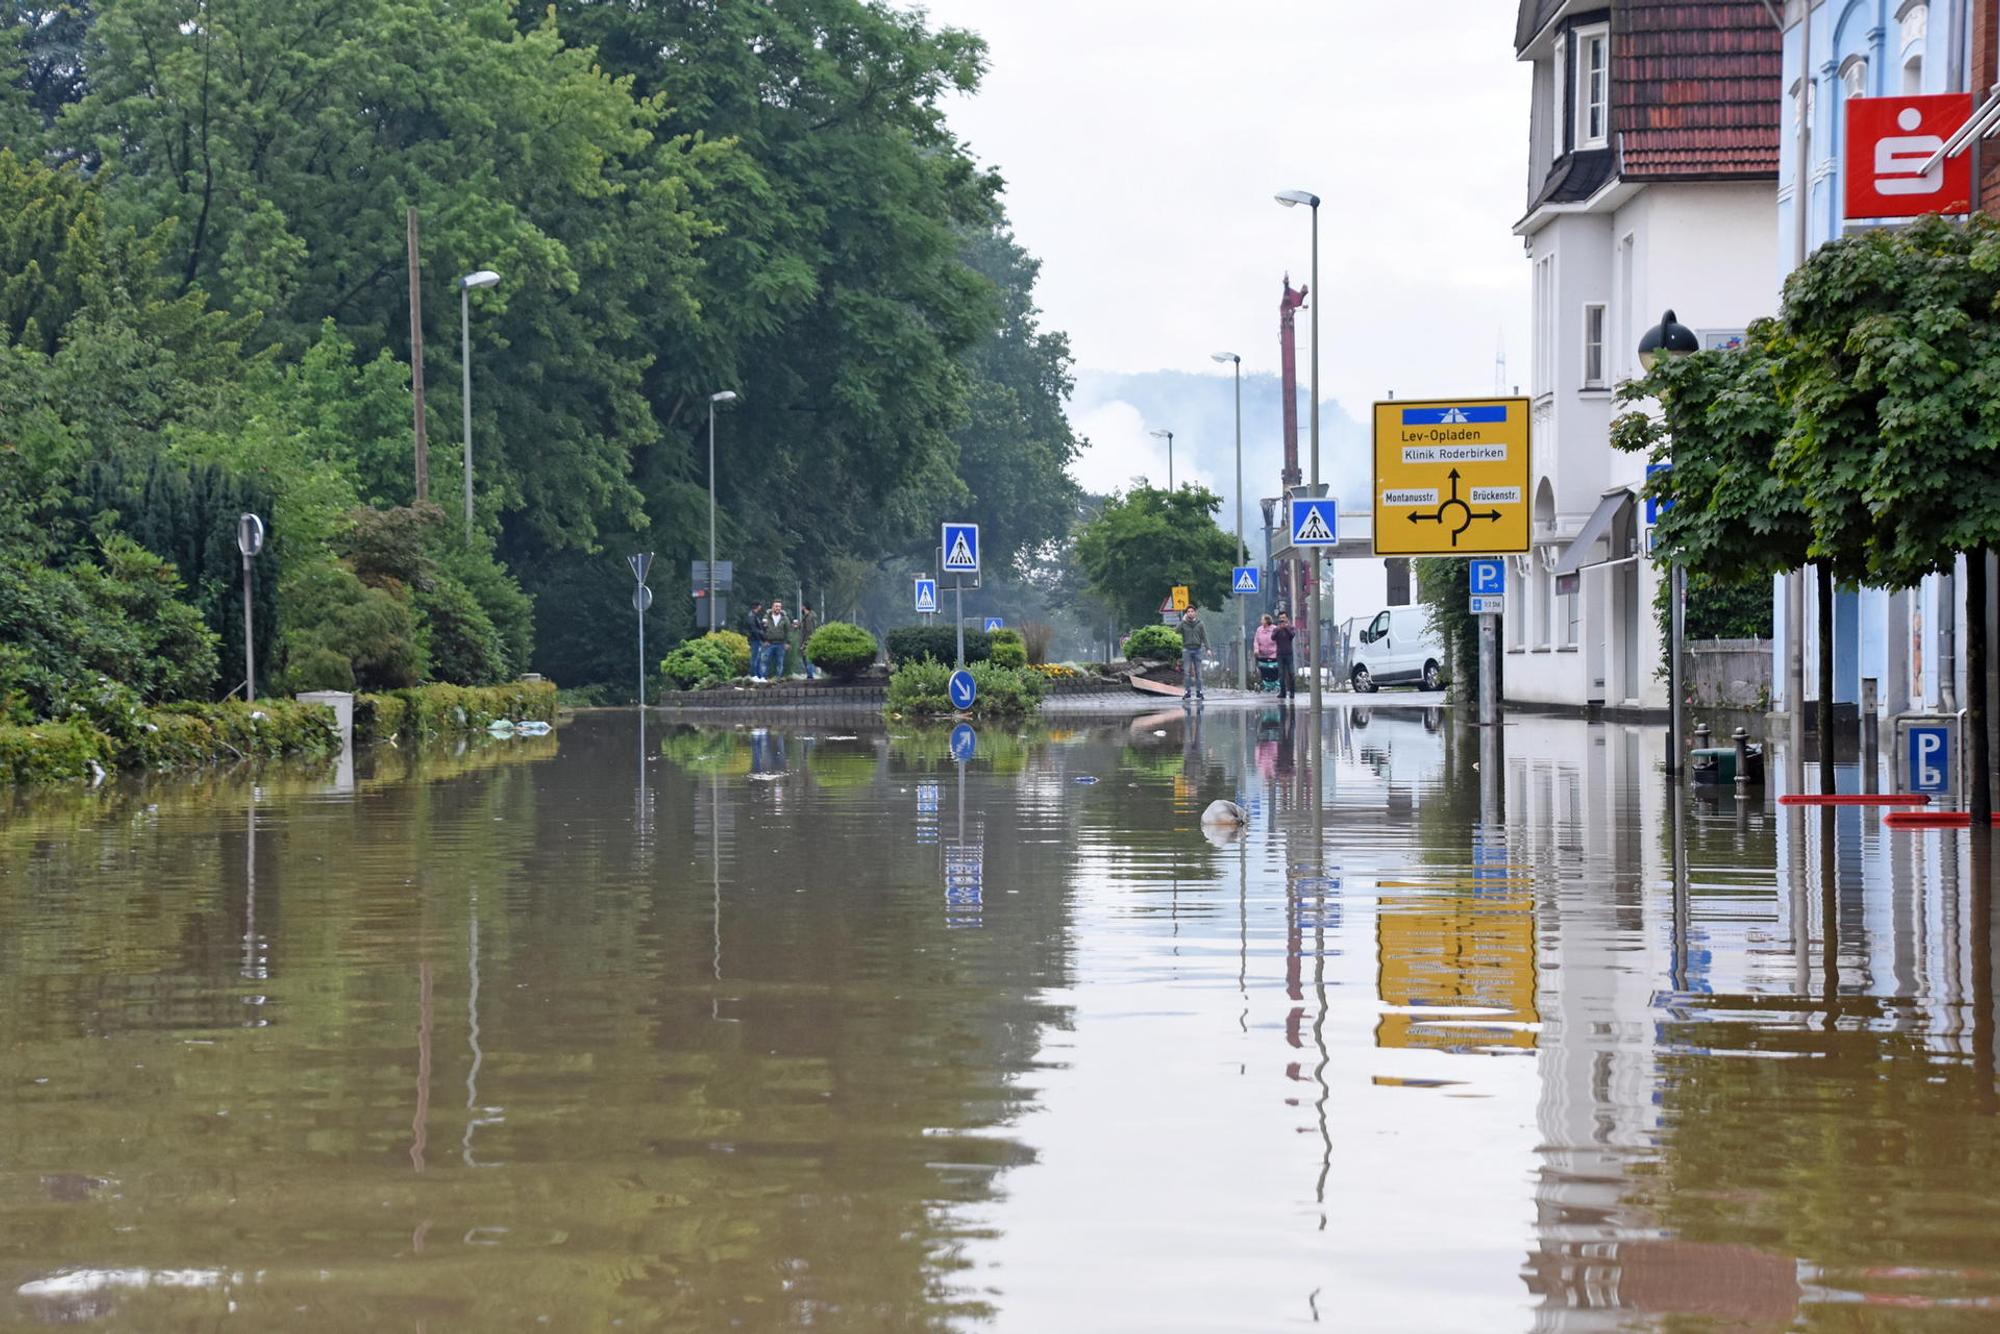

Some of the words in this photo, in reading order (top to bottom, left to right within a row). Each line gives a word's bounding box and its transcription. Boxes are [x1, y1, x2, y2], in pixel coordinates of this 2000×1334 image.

[1402, 429, 1480, 443] Lev-Opladen
[1405, 450, 1434, 460] Klinik
[1440, 448, 1503, 459] Roderbirken
[1386, 492, 1435, 503] Montanusstr.
[1473, 490, 1518, 501] Brückenstr.
[1478, 564, 1497, 590] P
[1918, 733, 1941, 760] P
